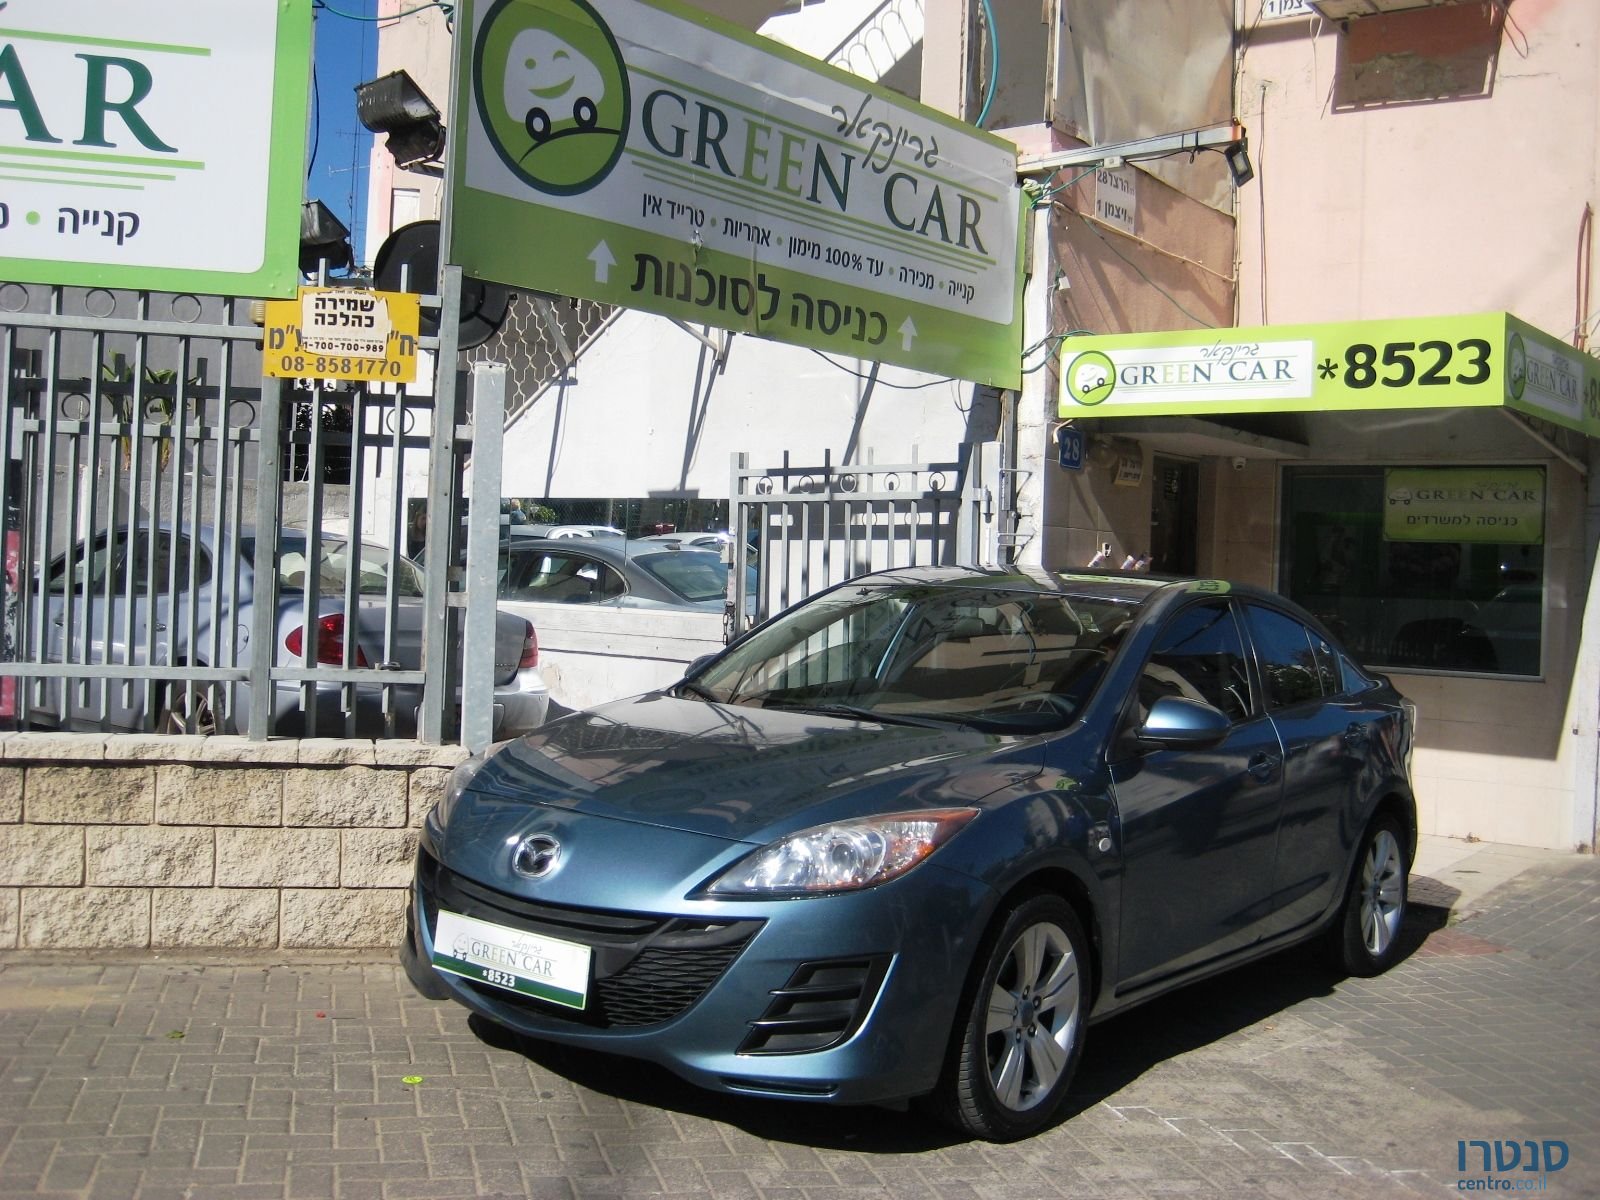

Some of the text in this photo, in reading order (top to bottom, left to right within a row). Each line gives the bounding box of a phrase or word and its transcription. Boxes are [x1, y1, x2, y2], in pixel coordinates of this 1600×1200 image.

[832, 93, 938, 174] גרינקאר
[641, 89, 989, 256] GREEN CAR
[58, 207, 140, 245] קנייה
[642, 193, 975, 304] קנייה מכירה עד 100% מימון אחריות טרייד אין
[314, 297, 375, 312] שמירה
[630, 251, 889, 346] כניסה לסוכנות
[314, 312, 374, 328] כהלכה
[303, 341, 384, 352] 1-700-700-989
[281, 355, 401, 376] 08-8581770
[1120, 362, 1213, 386] GREEN
[1228, 359, 1294, 381] CAR
[1063, 437, 1080, 461] 28
[1416, 489, 1537, 501] GREEN CAR
[1407, 514, 1518, 526] כניסה למשרדים
[471, 941, 553, 977] GREEN CAR
